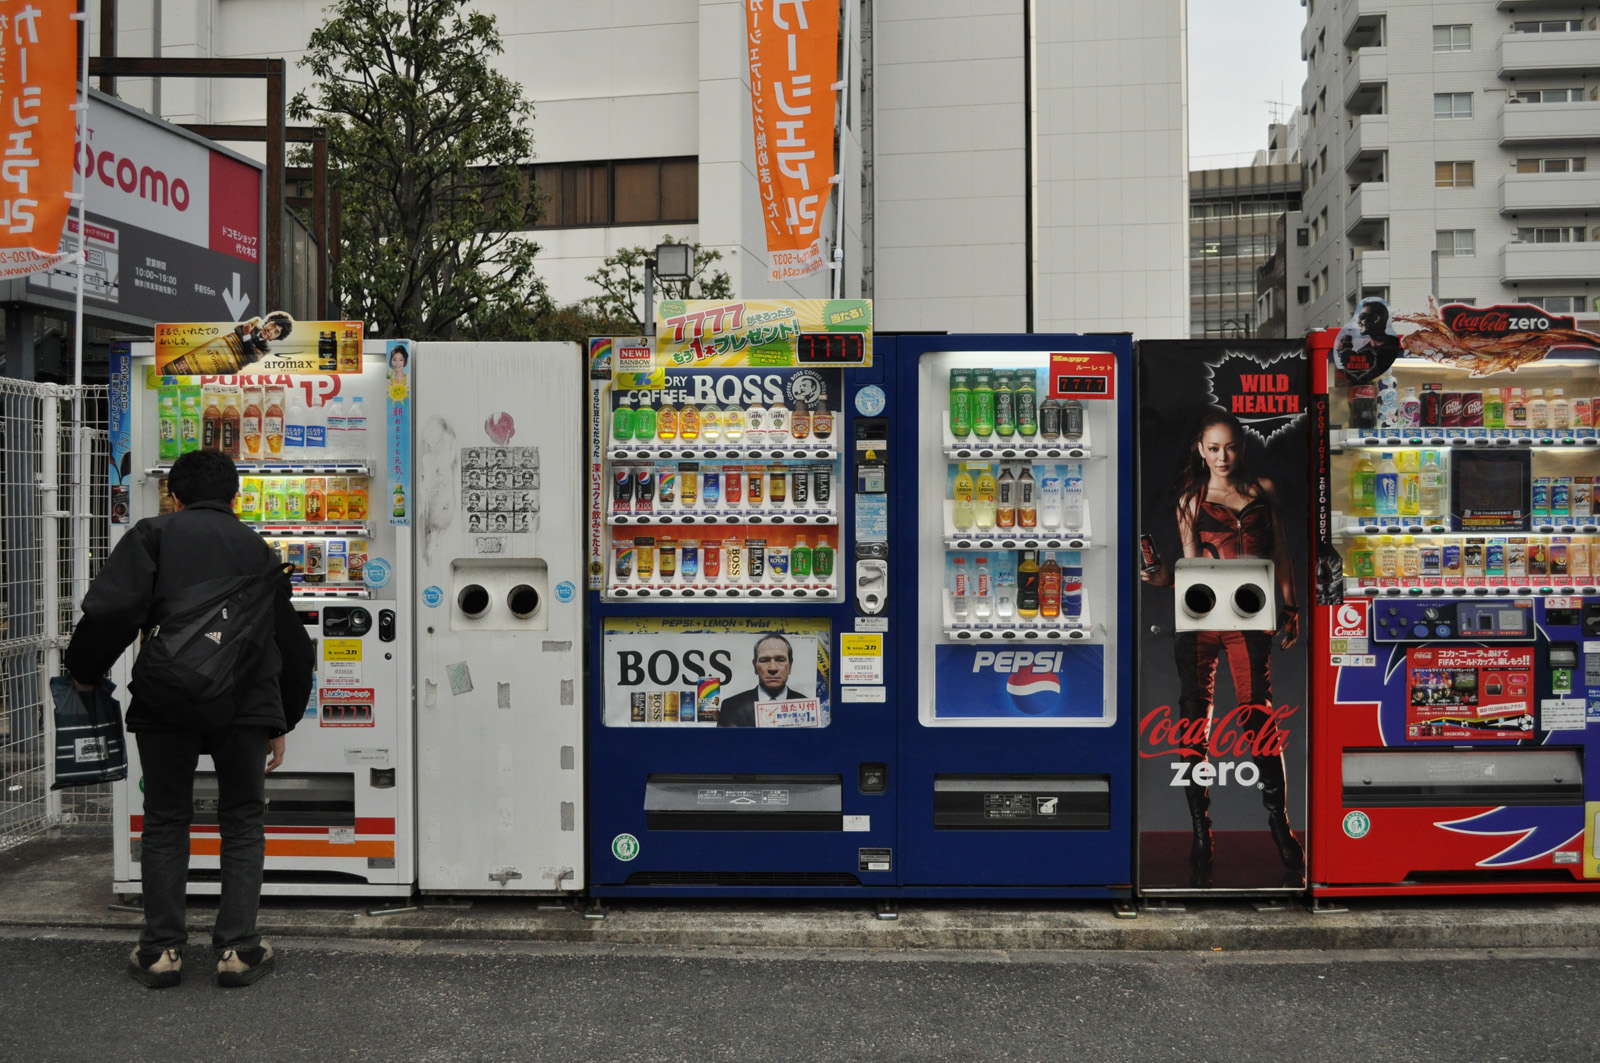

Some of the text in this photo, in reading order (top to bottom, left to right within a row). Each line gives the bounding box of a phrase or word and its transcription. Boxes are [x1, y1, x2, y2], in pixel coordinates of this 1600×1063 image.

[73, 141, 189, 211] ocomo
[222, 226, 257, 246] ドコモショップ
[236, 243, 257, 259] 代々木店
[145, 257, 167, 270] 営業時間
[159, 327, 219, 337] まるで、いれたての
[666, 302, 745, 343] 7777
[1508, 317, 1549, 330] zero
[621, 349, 649, 358] NEW!!
[802, 336, 862, 359] 7777
[264, 360, 314, 369] aromax
[1052, 355, 1090, 363] Happy
[692, 374, 784, 405] BOSS
[1060, 378, 1104, 391] 7777
[1240, 374, 1290, 393] WILD
[1231, 394, 1300, 413] HEALTH
[591, 388, 602, 557] さらに豆にこだわった 深いコクと飲みごたえ
[1316, 401, 1328, 545] Great taste zero sugar.
[798, 474, 806, 501] BLACK
[820, 474, 828, 500] BLACK
[731, 549, 740, 576] BOSS
[753, 549, 762, 575] BLACK
[703, 619, 736, 628] LEMON
[745, 618, 771, 628] Twist
[1334, 626, 1364, 637] Cmode
[972, 651, 1063, 674] PEPSI
[1438, 650, 1509, 658] コカ・コーラをあけて
[616, 650, 733, 686] BOSS
[325, 706, 369, 720] 7777
[780, 702, 815, 714] 当たり付
[1139, 704, 1299, 758] Coca-Cola
[1169, 761, 1259, 787] zero
